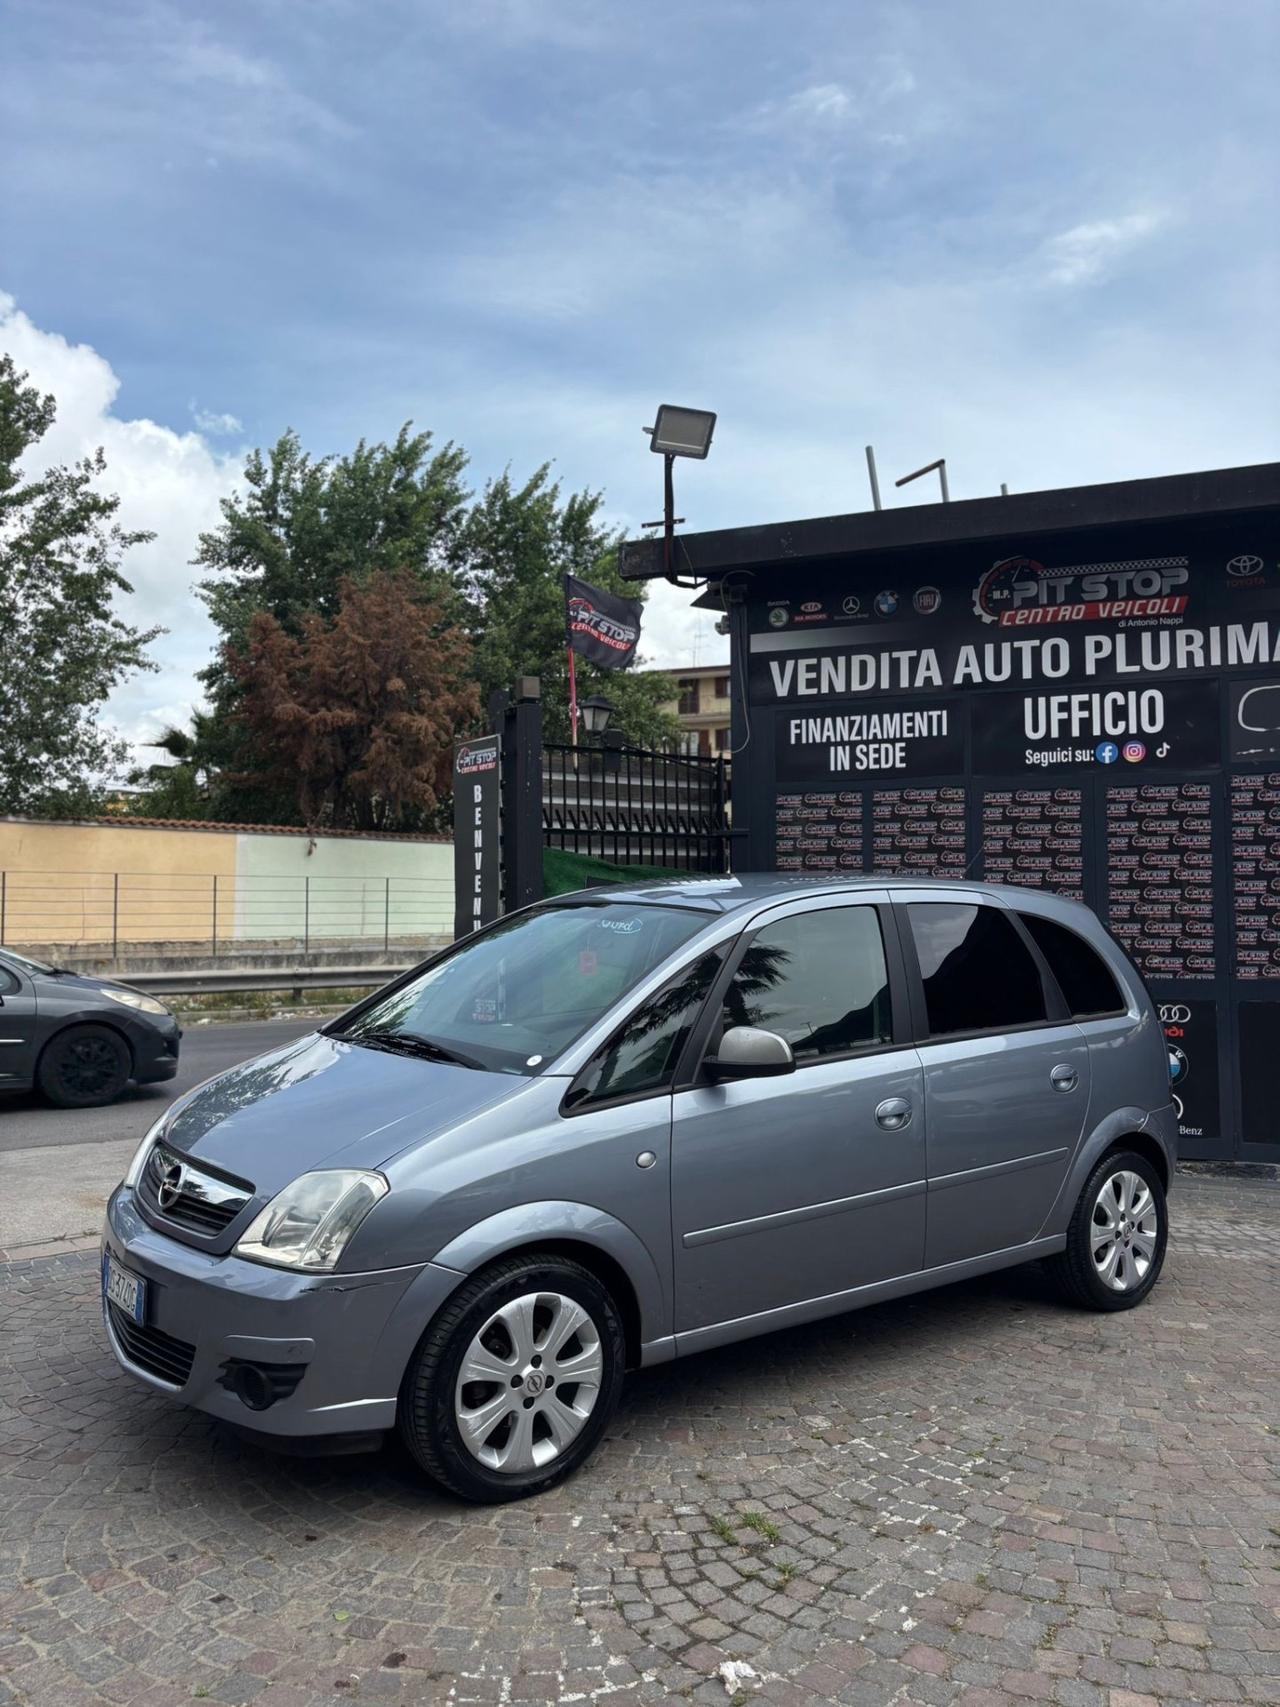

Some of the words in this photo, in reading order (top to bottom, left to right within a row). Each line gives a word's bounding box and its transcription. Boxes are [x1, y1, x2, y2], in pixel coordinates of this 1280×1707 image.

[1012, 576, 1075, 609] PIT
[1081, 567, 1189, 601] STOP
[577, 610, 601, 627] PIT
[598, 620, 636, 642] STOP
[1002, 603, 1086, 626] CENTRO
[1099, 597, 1181, 618] VEICOLI
[1118, 618, 1126, 628] di
[1127, 617, 1158, 628] Antonio
[1159, 616, 1183, 627] Nappi
[769, 648, 943, 697] VENDITA
[953, 637, 1070, 684] AUTO
[1084, 621, 1280, 675] PLURIM
[790, 710, 948, 744] FINANZIAMENTI
[1024, 689, 1164, 740] UFFICIO
[476, 751, 497, 764] STOP
[830, 745, 850, 771] IN
[855, 742, 906, 770] SEDE
[1025, 747, 1072, 767] Seguici
[1075, 748, 1095, 762] su:
[1179, 1125, 1203, 1136] Benz
